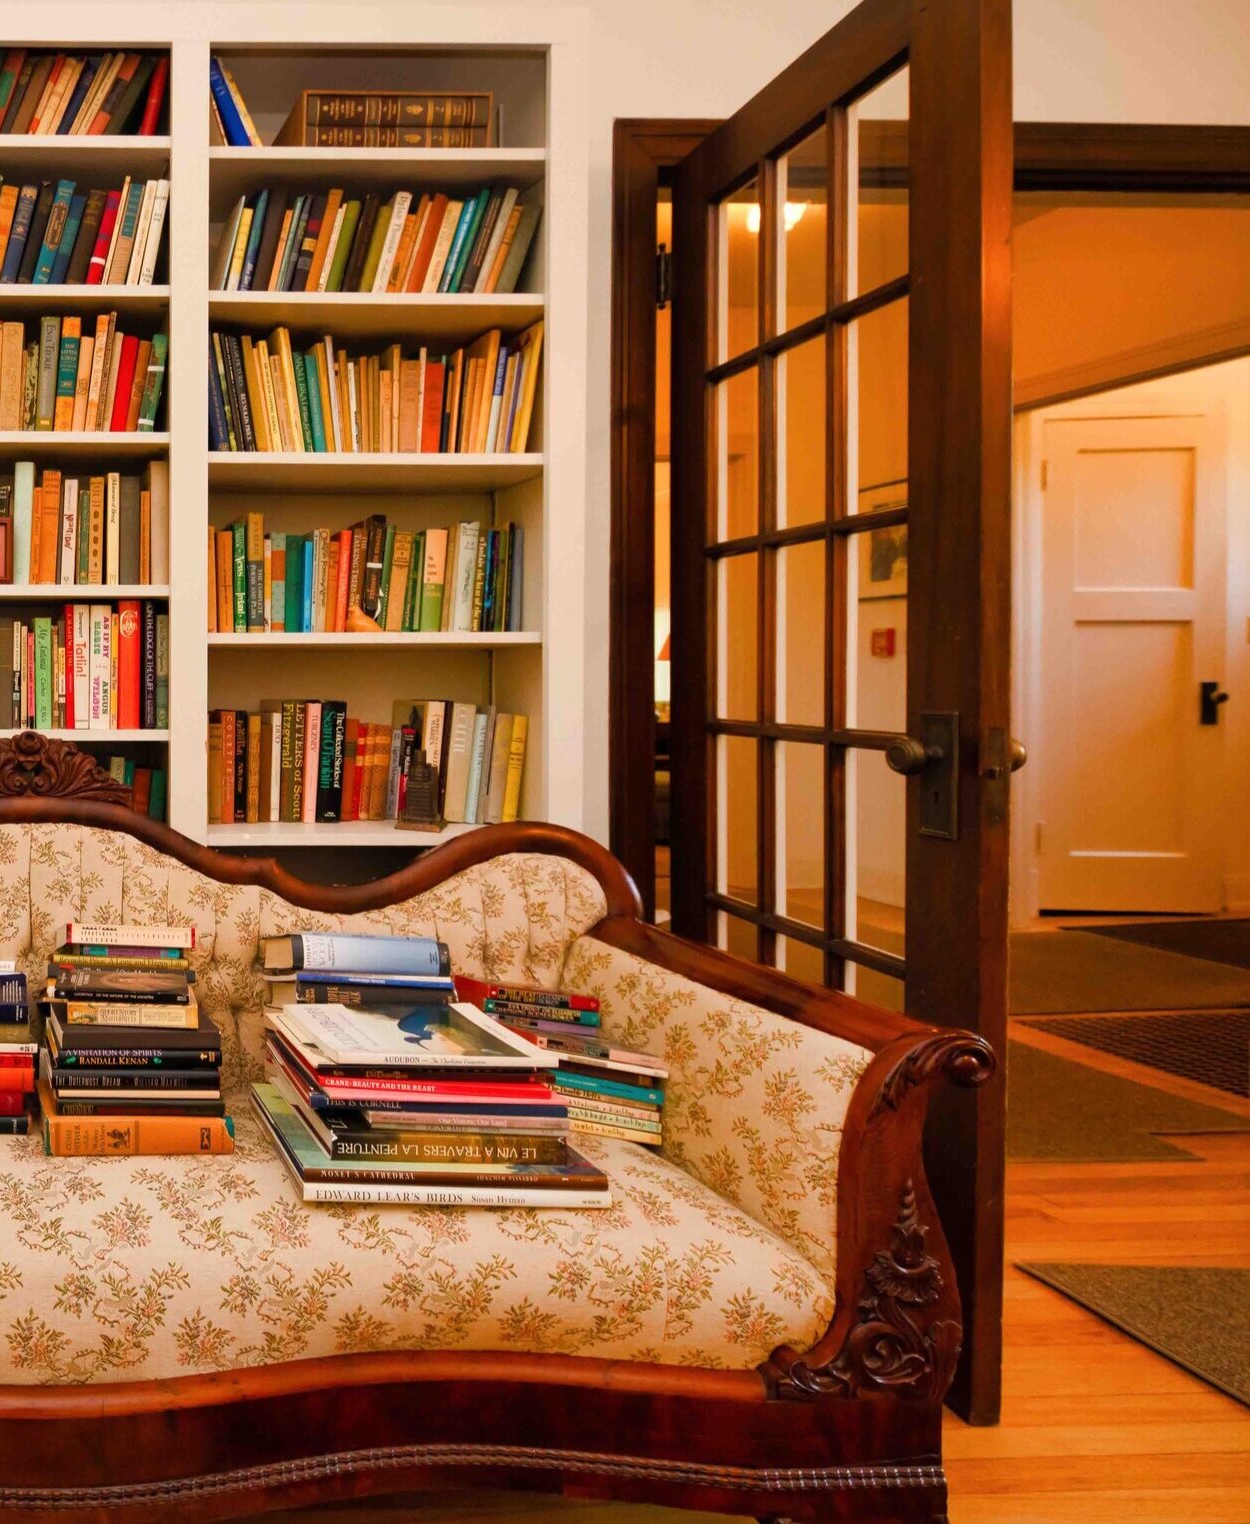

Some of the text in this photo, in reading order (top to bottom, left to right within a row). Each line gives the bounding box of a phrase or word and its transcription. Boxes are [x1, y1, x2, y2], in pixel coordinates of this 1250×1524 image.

[387, 194, 410, 254] Dylan Thomas
[43, 323, 57, 370] Eva Trout
[476, 537, 487, 568] o'faolain
[350, 533, 361, 593] TALKING TREES
[249, 563, 258, 584] POEMS
[475, 570, 484, 580] the
[146, 605, 154, 618] ON
[249, 600, 257, 619] PLAYS
[473, 607, 482, 618] the
[146, 618, 154, 631] THE
[472, 619, 480, 631] sun
[75, 611, 88, 677] Davenport Tatlin!
[102, 616, 110, 658] AS IF BY
[146, 631, 154, 650] EDGE
[146, 650, 154, 661] OF
[146, 661, 154, 673] THE
[146, 673, 154, 691] CLIFF
[92, 676, 101, 720] WILSON
[101, 680, 109, 715] ANGUS
[281, 702, 294, 769] Fitzgerald
[309, 713, 319, 753] TURGENEV
[225, 714, 234, 774] COLETTE
[319, 710, 337, 789] Sean O'Faolain
[332, 711, 346, 789] The Collected Stories of
[477, 726, 487, 766] AUTUMN
[292, 703, 306, 820] LETTERS of Scott
[100, 1008, 137, 1016] SHORT STORY
[79, 1056, 148, 1065] RANDALL KENAN
[55, 1075, 188, 1087] THE OUTERMOST DREAM WILLIAM MAXWELL
[325, 1078, 349, 1086] CRANE
[412, 1084, 436, 1092] BEAST
[324, 1097, 401, 1109] THIS IS CORNELL
[452, 1117, 475, 1126] Voices,
[65, 1129, 73, 1150] COME
[337, 1142, 538, 1159] LE VIN A TRAVERS LA PEINTURE
[320, 1169, 359, 1179] MONET'S
[362, 1171, 416, 1180] CATHEDRAL
[316, 1189, 526, 1205] EDWARD LEAR'S BIRDS Susan Hyman
